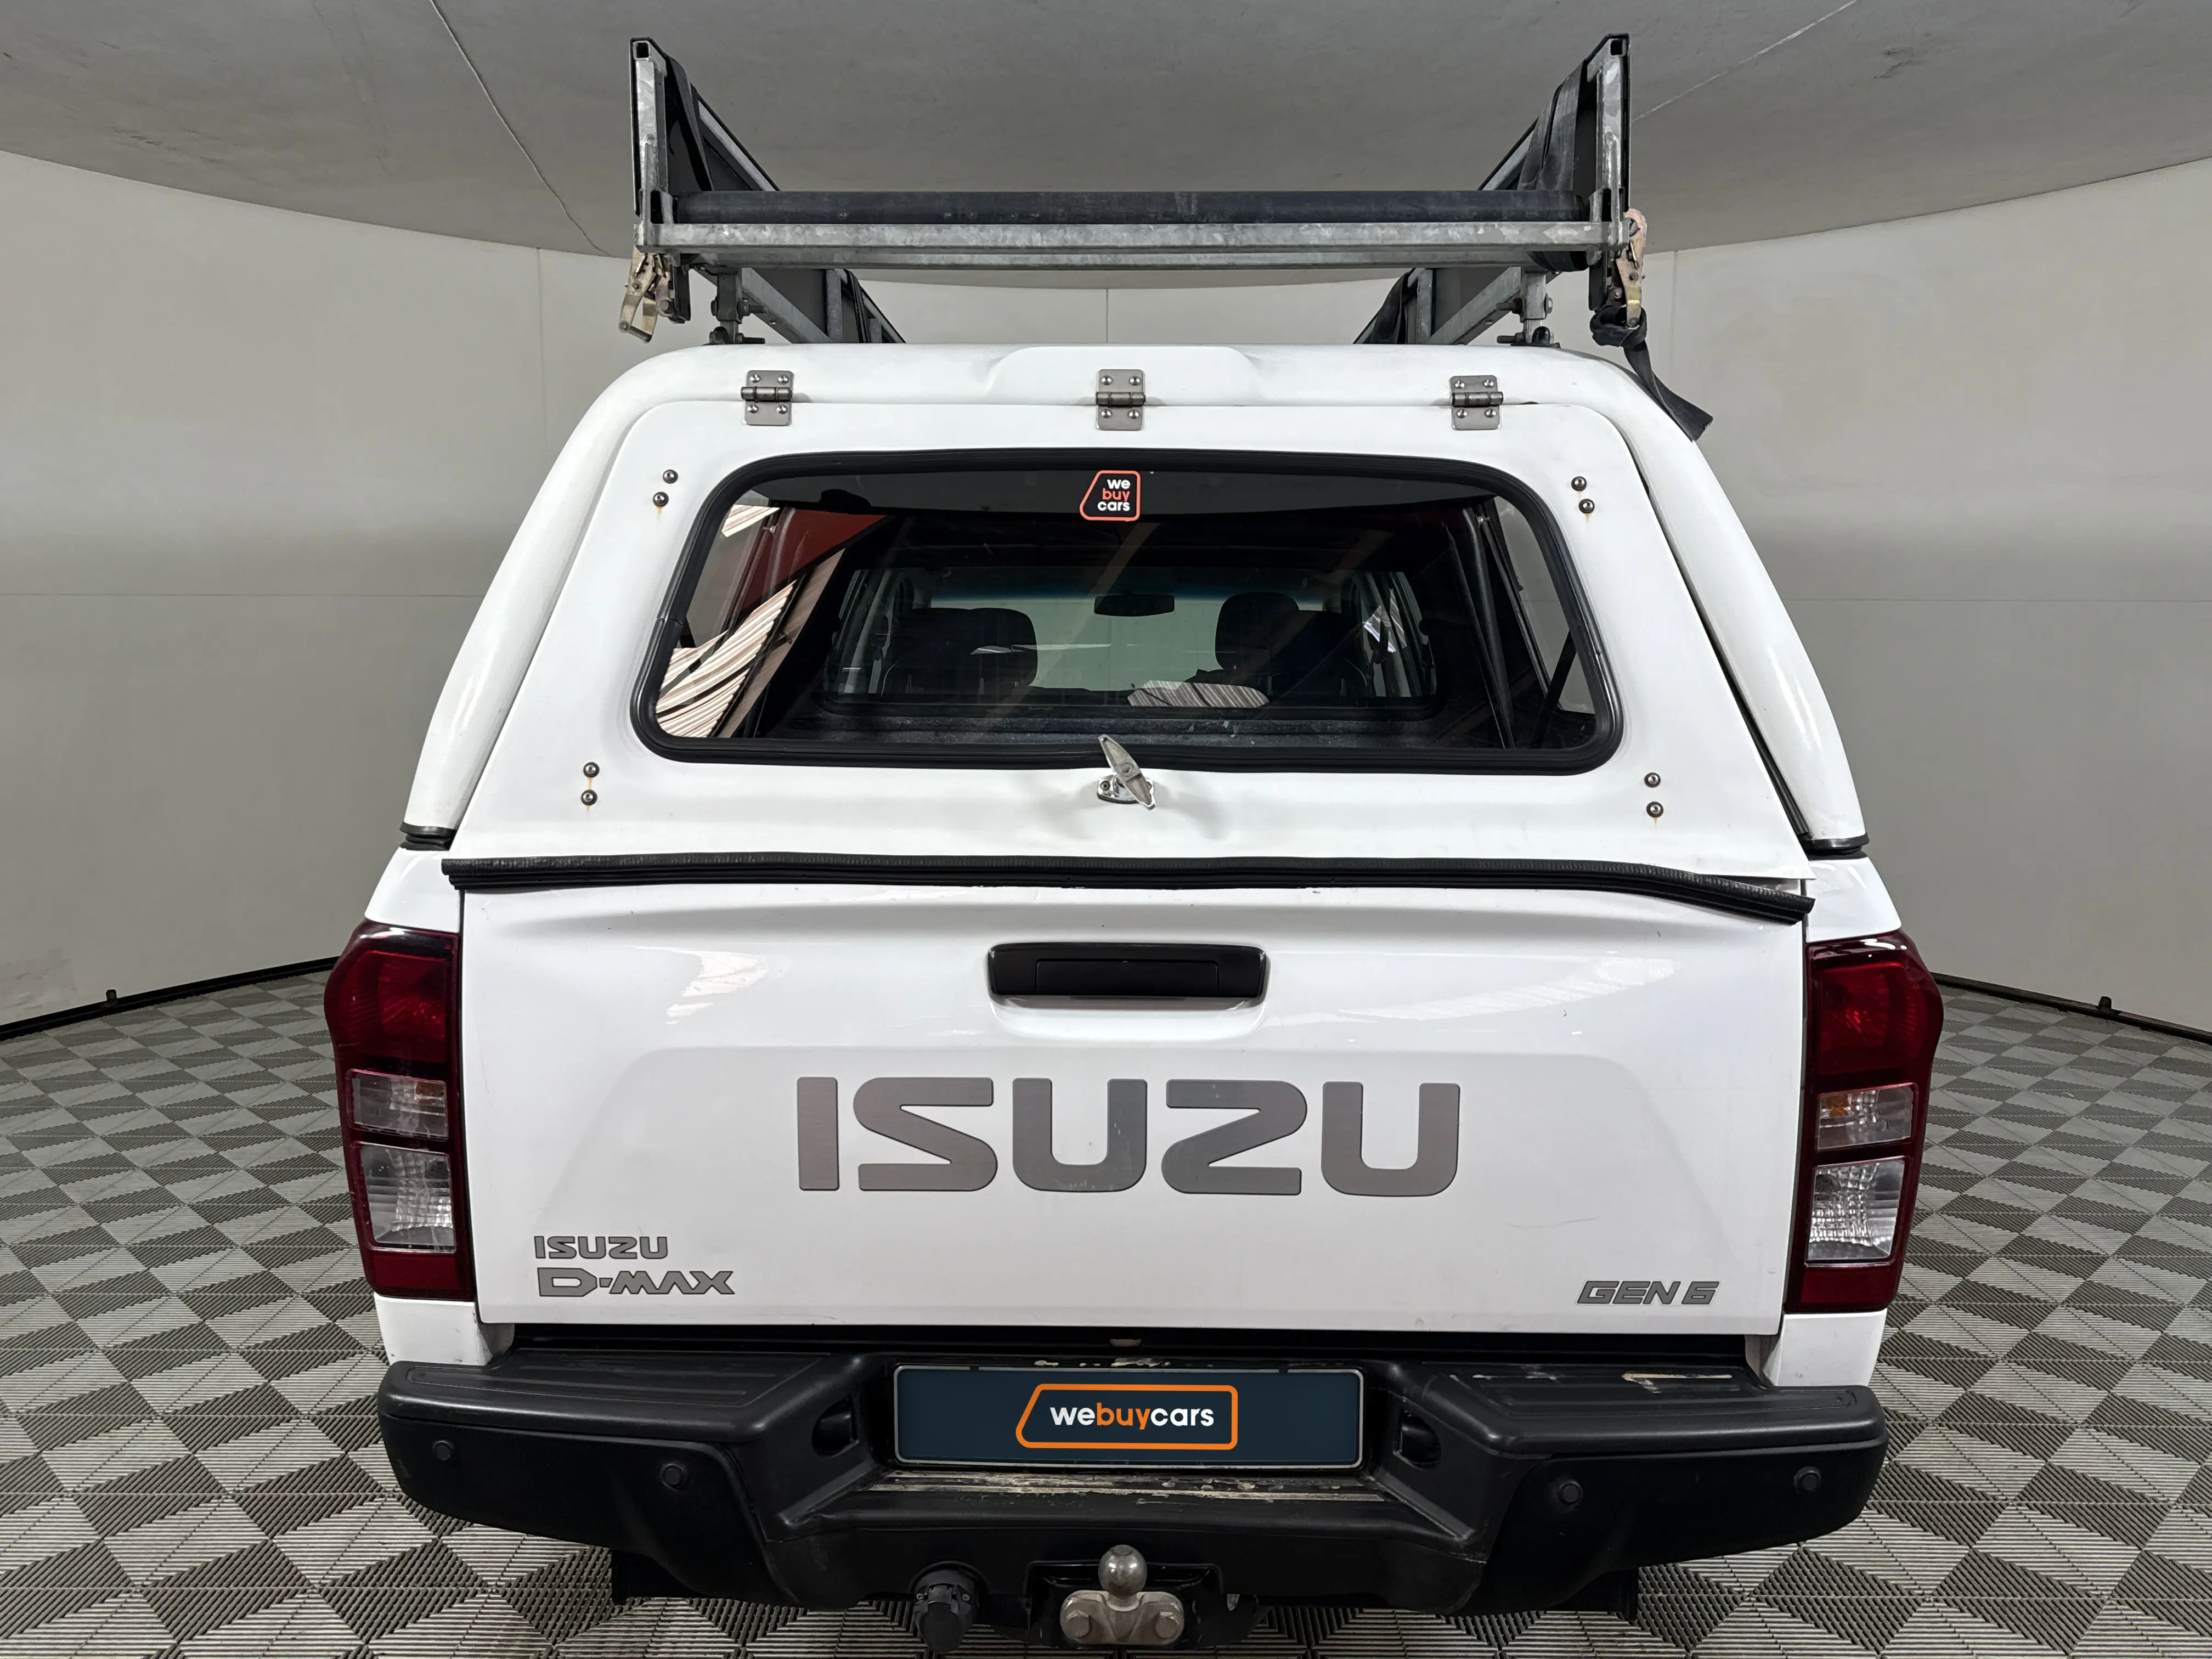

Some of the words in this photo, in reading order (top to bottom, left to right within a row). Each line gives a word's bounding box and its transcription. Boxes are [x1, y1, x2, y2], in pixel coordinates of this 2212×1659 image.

[1102, 488, 1131, 501] buy
[1107, 479, 1131, 489] we
[1097, 501, 1130, 511] cars
[797, 1076, 1460, 1197] ISUZU
[534, 1235, 668, 1259] ISUZU
[537, 1267, 735, 1297] D-MAX
[1577, 1280, 1681, 1305] GEN
[1681, 1281, 1720, 1305] 6
